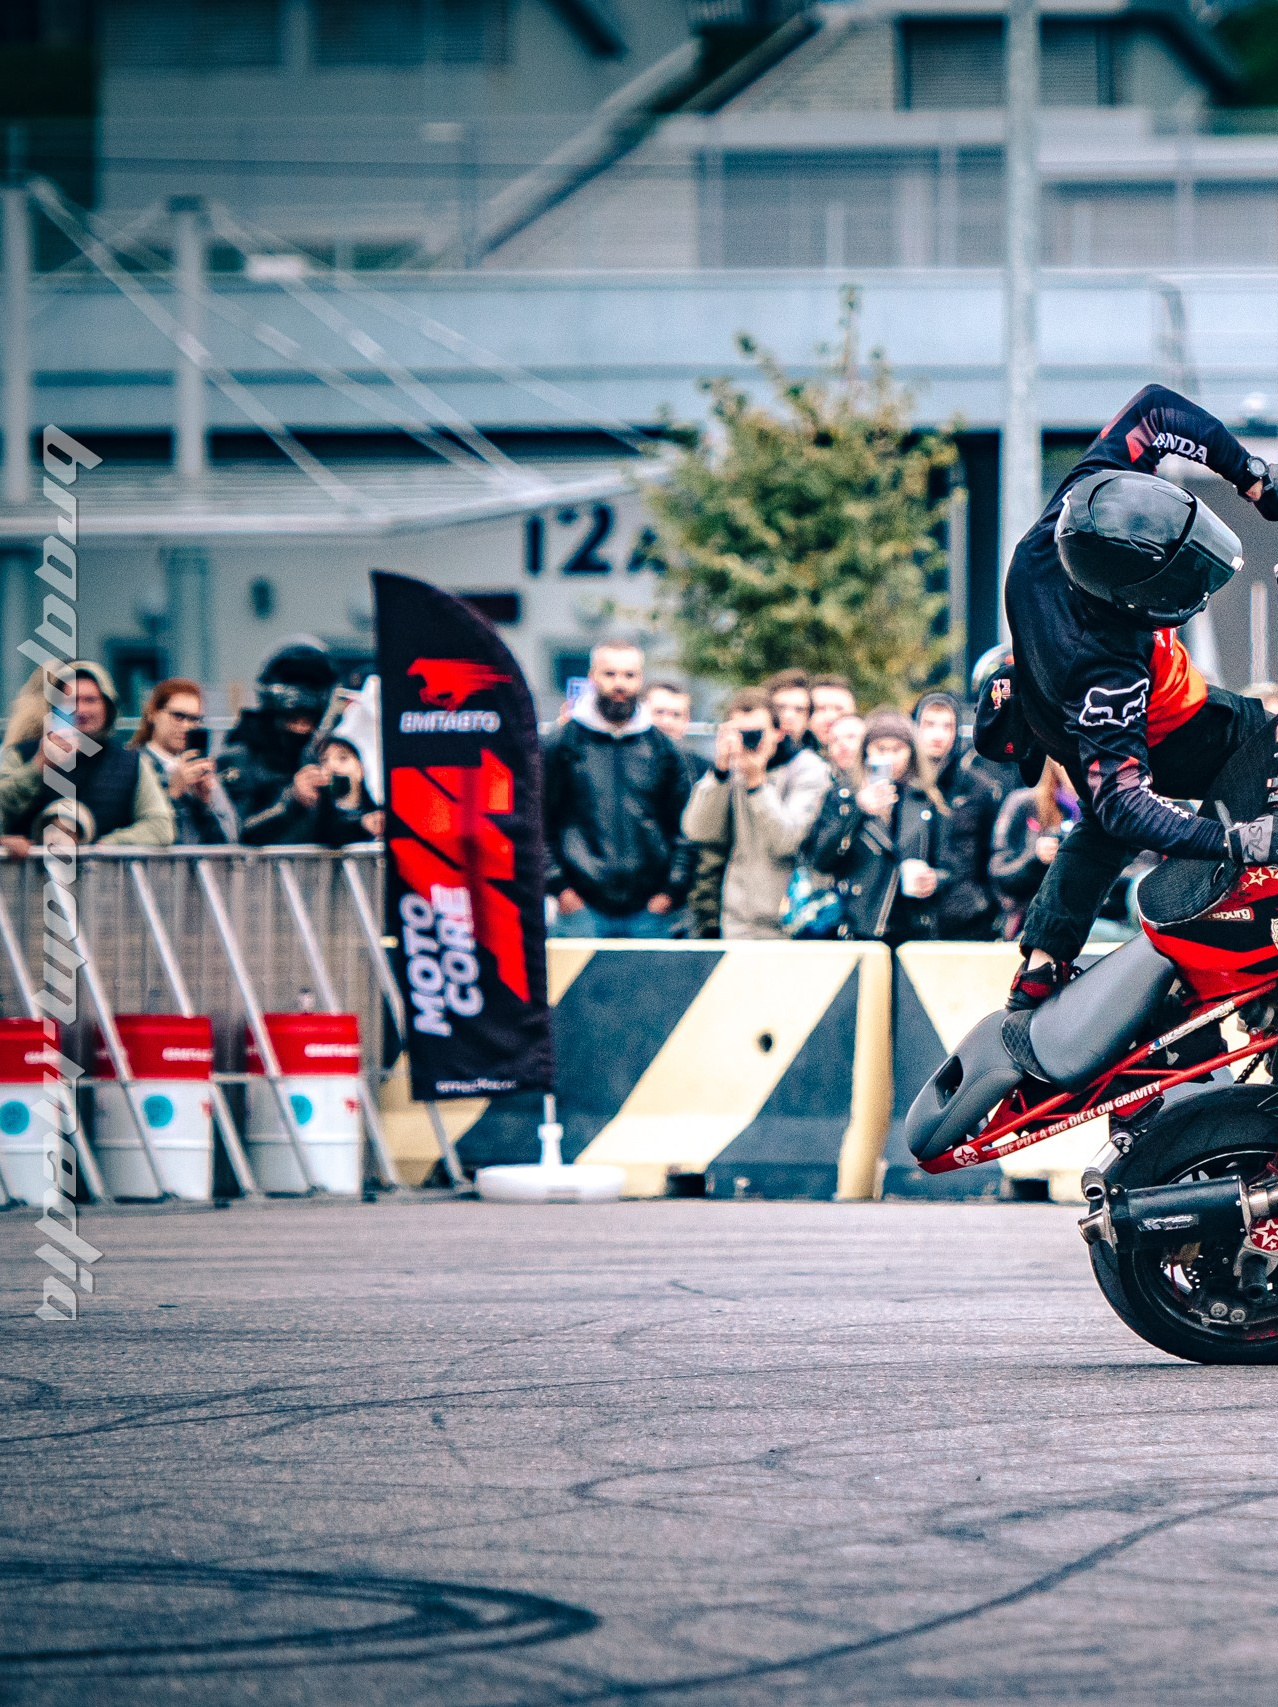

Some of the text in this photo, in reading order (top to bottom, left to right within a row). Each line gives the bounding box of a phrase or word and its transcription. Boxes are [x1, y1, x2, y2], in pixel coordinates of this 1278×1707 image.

[400, 892, 452, 1037] MOTO
[431, 883, 484, 1017] CORE
[998, 1081, 1161, 1156] WE PUT A BIG DICK ON GRAVITY
